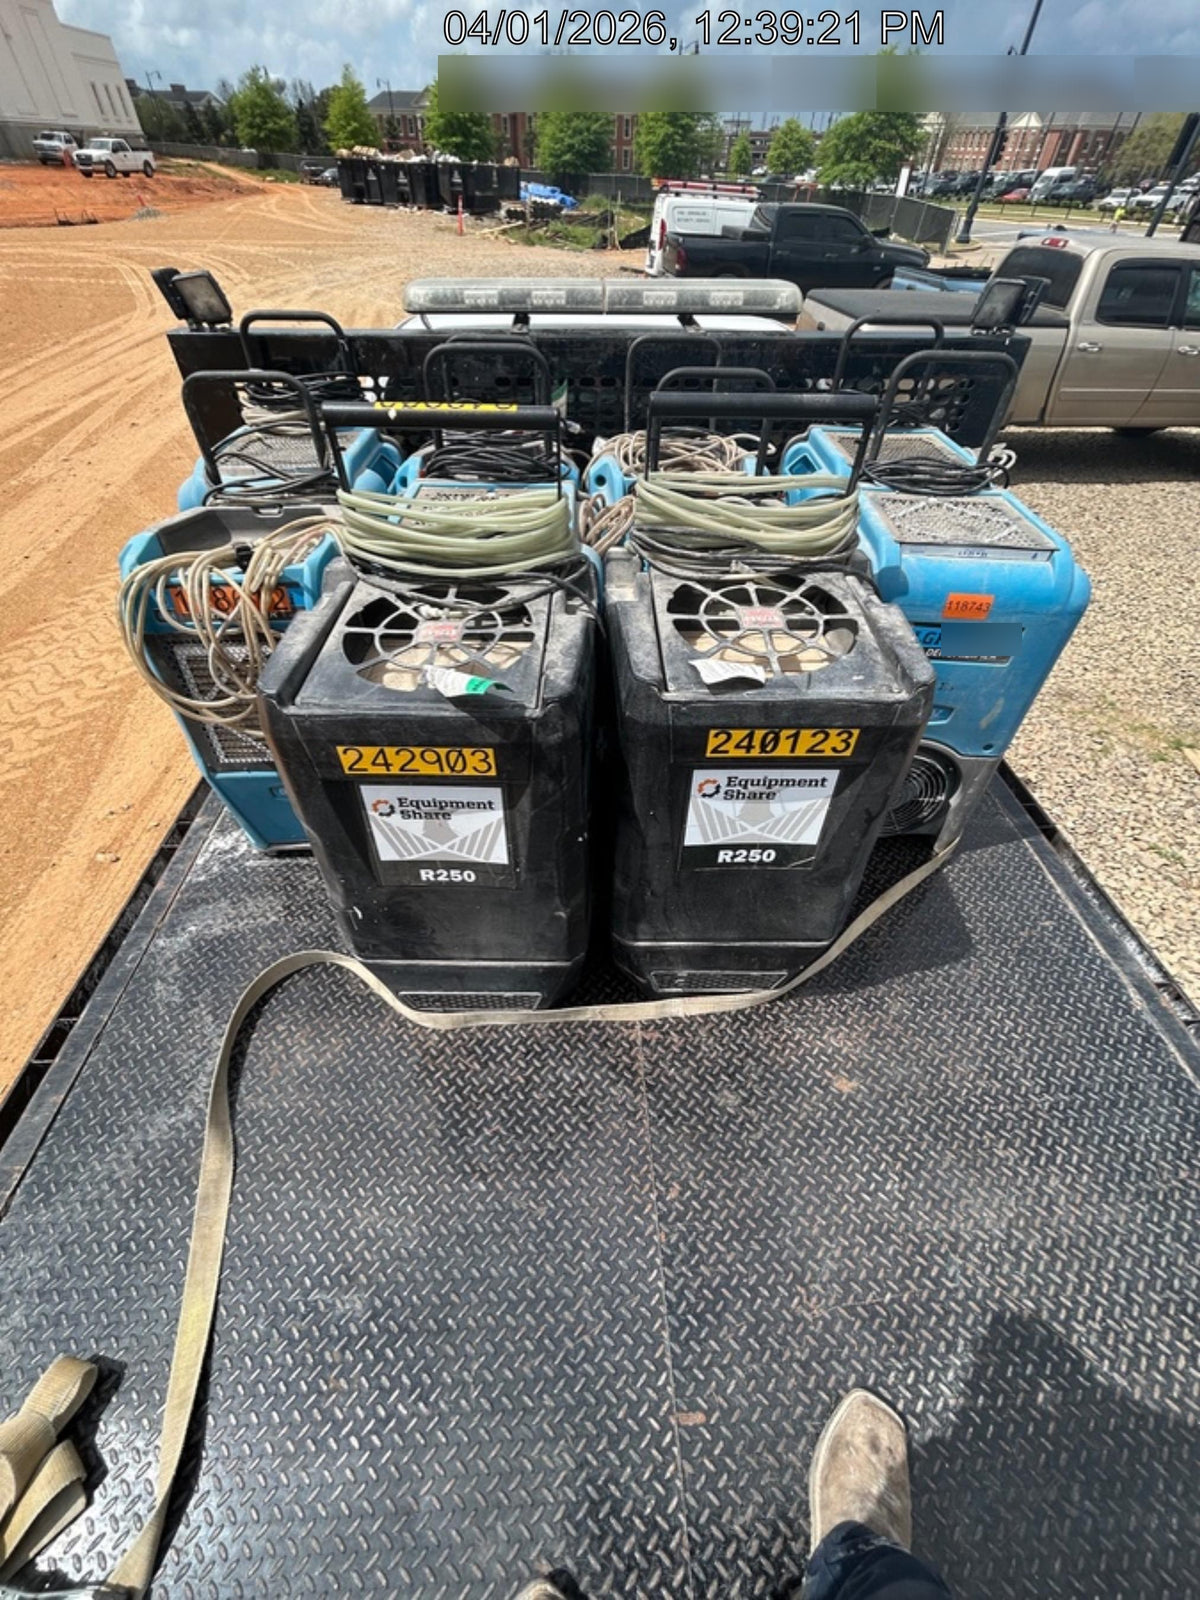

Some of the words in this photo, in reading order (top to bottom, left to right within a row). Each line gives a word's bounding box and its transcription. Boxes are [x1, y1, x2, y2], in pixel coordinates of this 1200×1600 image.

[946, 601, 991, 612] 118743
[710, 729, 854, 755] 240123
[342, 748, 493, 773] 242903
[725, 776, 827, 788] Equipment
[723, 789, 776, 801] Share
[397, 797, 495, 810] Equipment
[400, 810, 452, 820] Share
[717, 849, 776, 863] R250
[419, 869, 476, 882] R250
